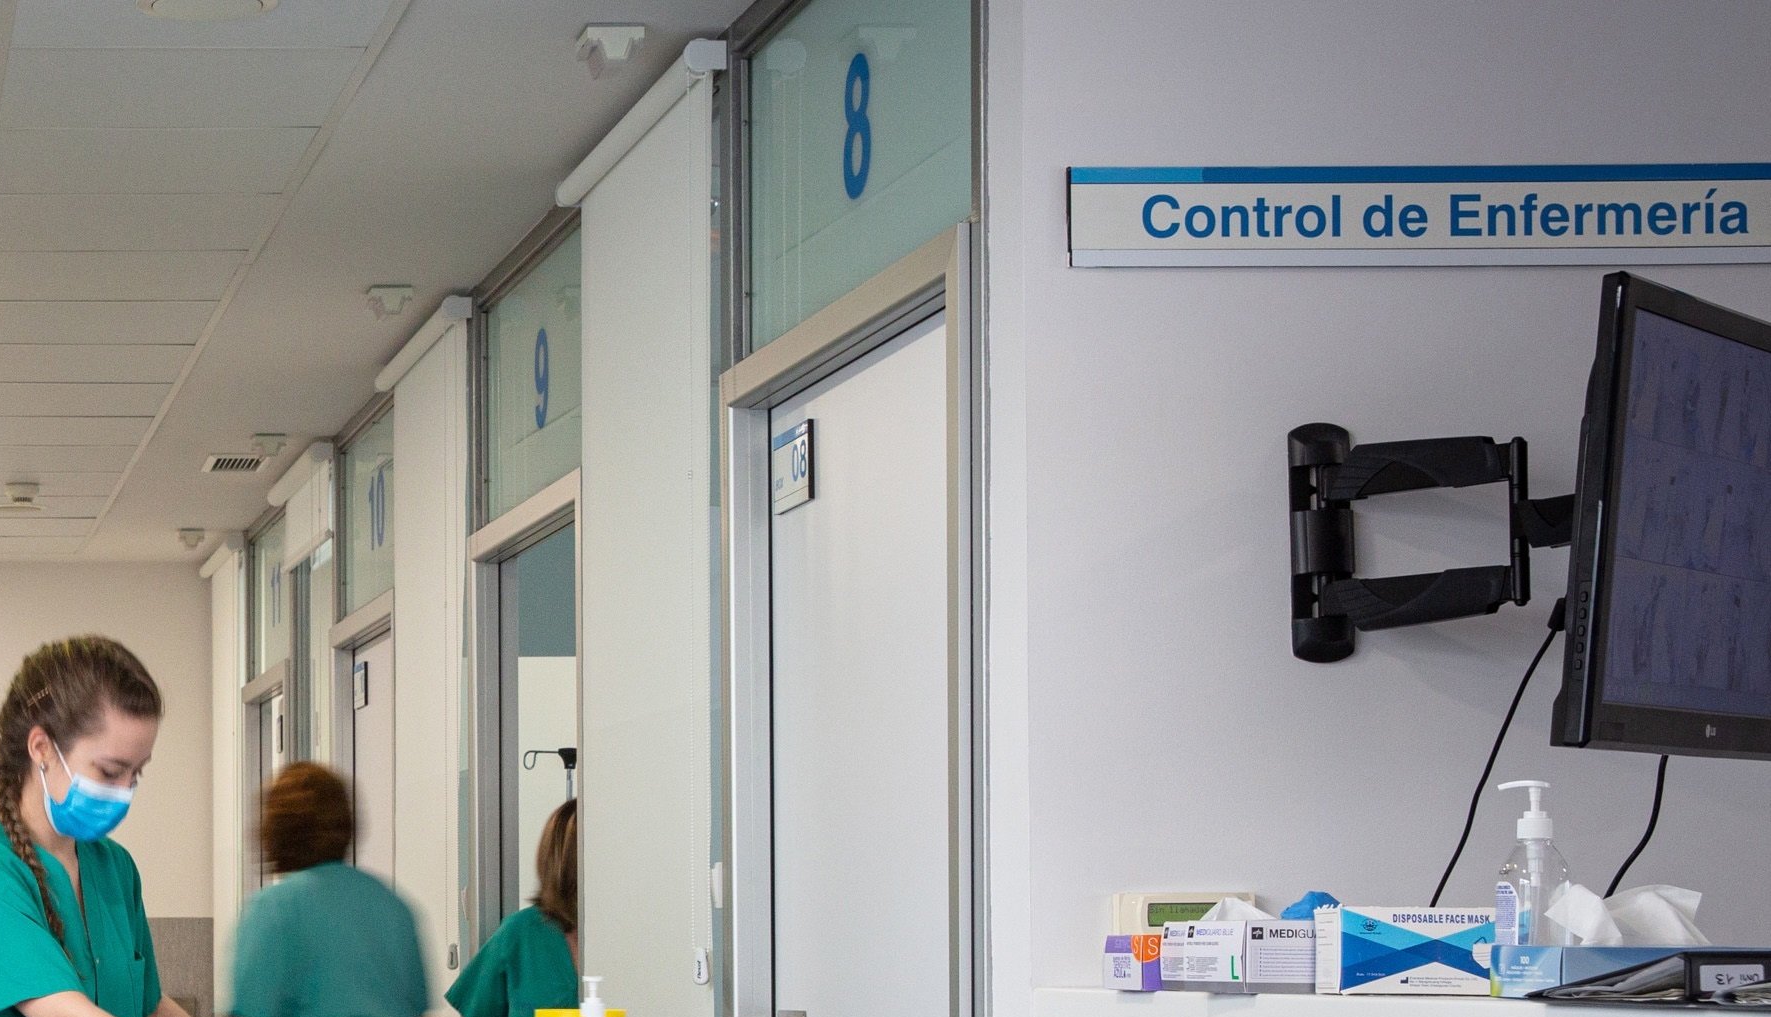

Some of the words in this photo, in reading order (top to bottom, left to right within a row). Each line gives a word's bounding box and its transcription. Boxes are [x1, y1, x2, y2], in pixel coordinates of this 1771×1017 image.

[843, 53, 871, 200] 8
[1142, 194, 1341, 238] Control
[1363, 194, 1428, 238] de
[1450, 188, 1749, 237] Enfermería
[534, 328, 548, 430] 9
[792, 439, 806, 482] 08
[368, 469, 385, 551] 10
[1392, 913, 1444, 924] DISPOSABLE
[1446, 914, 1466, 924] FACE
[1468, 915, 1490, 924] MASK
[1147, 937, 1159, 955] S
[1231, 954, 1239, 980] L
